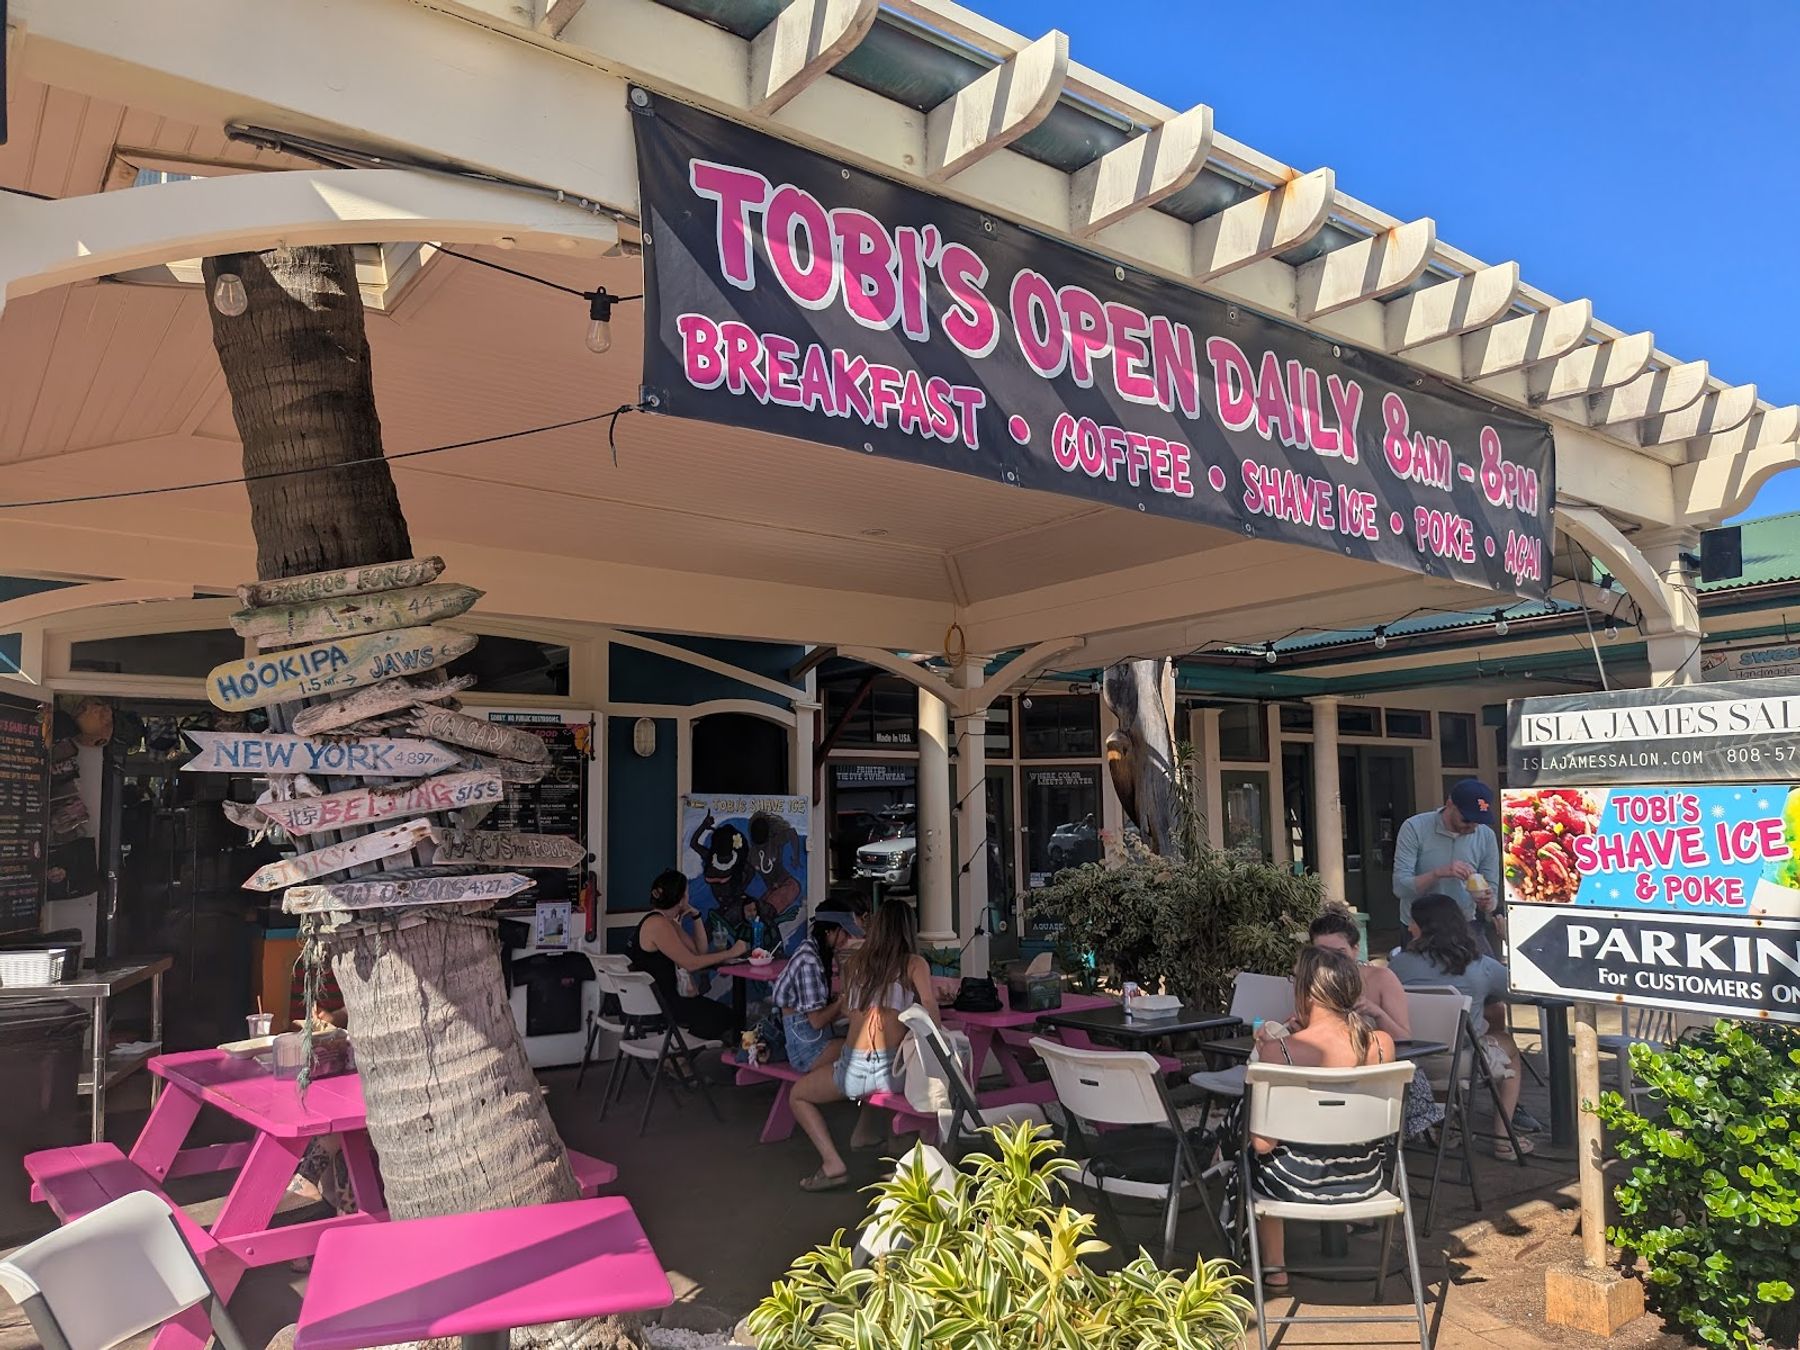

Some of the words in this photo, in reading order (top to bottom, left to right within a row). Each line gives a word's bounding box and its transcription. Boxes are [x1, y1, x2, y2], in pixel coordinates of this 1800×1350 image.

[689, 158, 999, 358] TOBI'S
[1009, 267, 1199, 420] OPEN
[1206, 336, 1363, 463] DAILY
[1383, 392, 1452, 492] 8AM
[1480, 425, 1538, 517] 8PM
[677, 313, 986, 450] BREAKFAST
[1051, 412, 1195, 497] COFFEE
[1241, 459, 1336, 531] SHAVE
[1339, 484, 1379, 540] ICE
[1415, 506, 1476, 564] POKE
[370, 646, 435, 679] JAWS
[1736, 666, 1794, 679] Handmade
[1740, 646, 1800, 665] swee
[298, 677, 322, 695] 1.5
[428, 713, 510, 751] CALGARY
[876, 732, 892, 743] Made
[898, 733, 912, 743] USA
[1524, 714, 1594, 743] ISLA
[1603, 705, 1718, 738] JAMES
[213, 740, 303, 769] NEW
[303, 742, 396, 770] YORK
[1522, 751, 1703, 771] ISLAJAMESSALON.COM
[1726, 746, 1796, 763] 808-57
[318, 782, 454, 829] BEIJING
[1612, 792, 1701, 826] TOBI'S
[272, 844, 360, 882] TOKY
[1572, 827, 1708, 876] SHAVE
[1716, 817, 1790, 865] ICE
[1634, 872, 1659, 901] &
[1663, 875, 1746, 906] POKE
[1566, 924, 1800, 977] PARKIN
[1598, 968, 1628, 986] For
[1634, 971, 1763, 1000] CUSTOMERS
